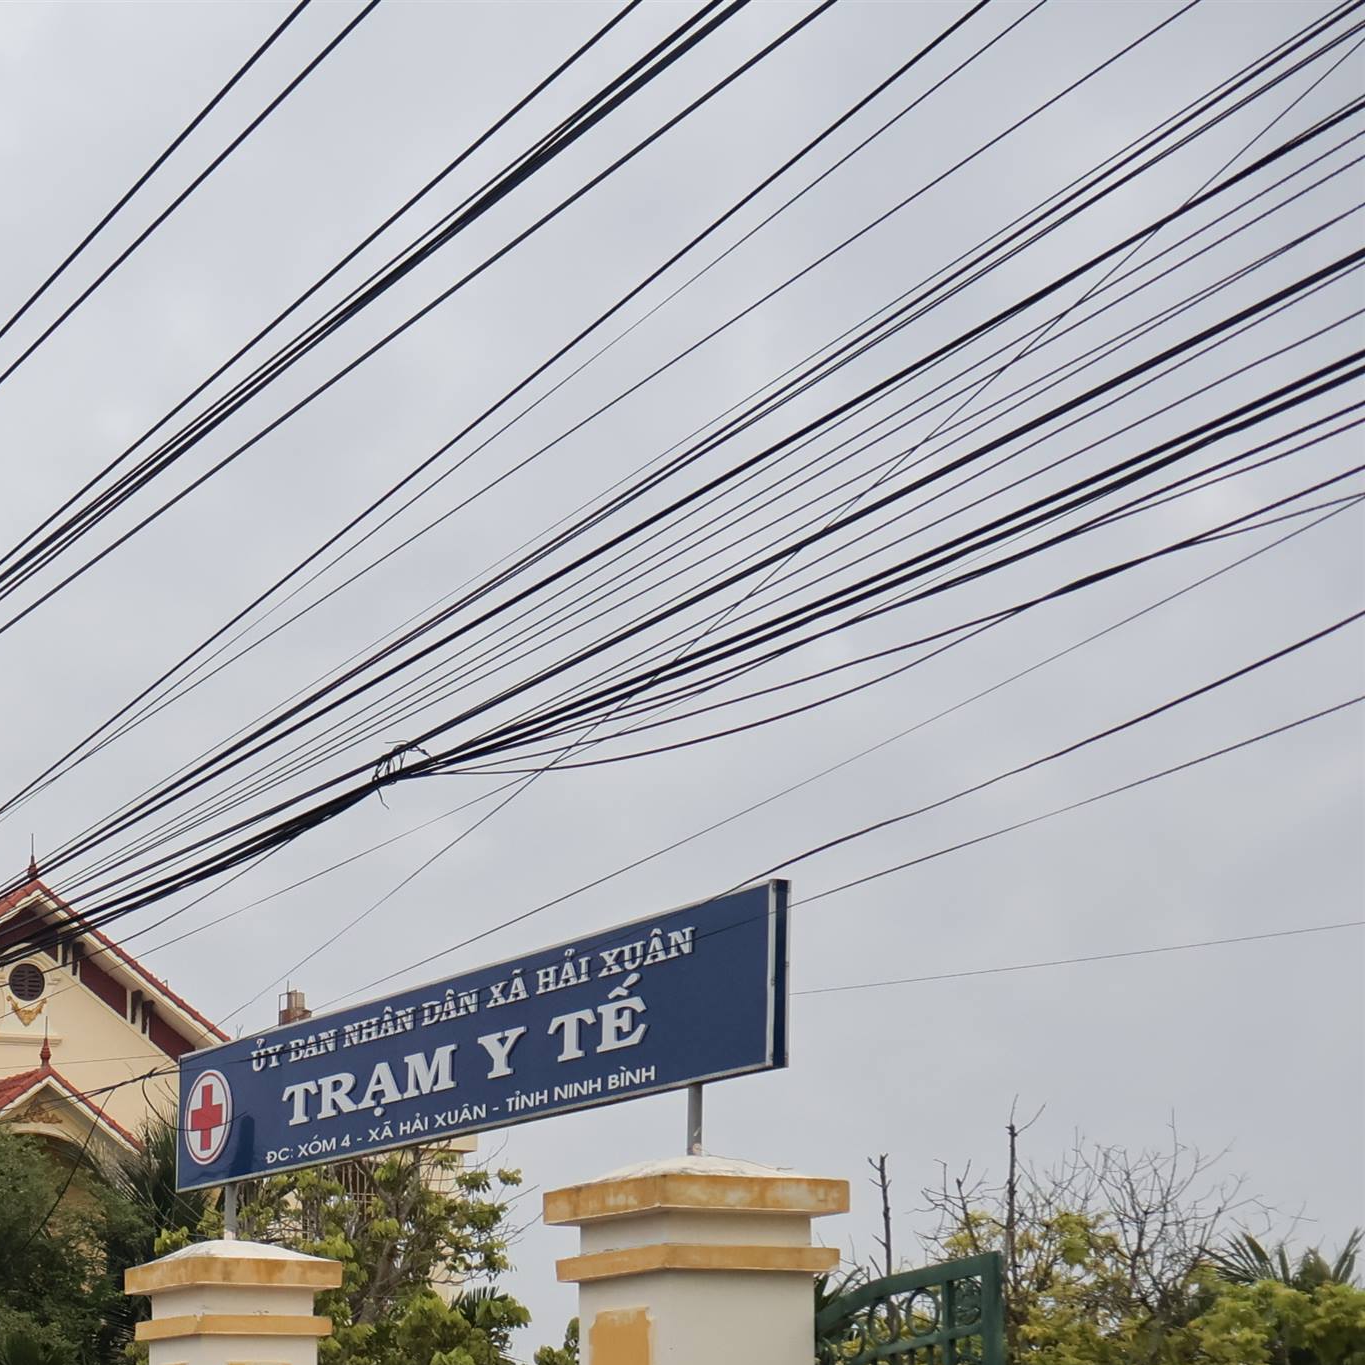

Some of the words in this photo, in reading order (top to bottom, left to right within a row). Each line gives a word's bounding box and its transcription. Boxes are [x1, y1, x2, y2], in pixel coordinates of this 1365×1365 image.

[343, 1006, 417, 1048] NHÂN
[486, 967, 530, 1009] XÃ
[536, 948, 592, 995] HẢI
[598, 926, 696, 978] XUÂN
[282, 1042, 459, 1127] TRẠM
[477, 1026, 527, 1080] Y
[547, 972, 648, 1063] TẾ
[265, 1147, 293, 1165] ĐC:
[297, 1133, 337, 1159] XÓM
[340, 1134, 352, 1149] 4
[368, 1120, 395, 1143] XÃ
[398, 1112, 429, 1136] HẢI
[434, 1103, 487, 1129] XUÂN
[505, 1090, 549, 1113] TỈNH
[553, 1077, 602, 1101] NINH
[607, 1065, 657, 1091] BÌNH
